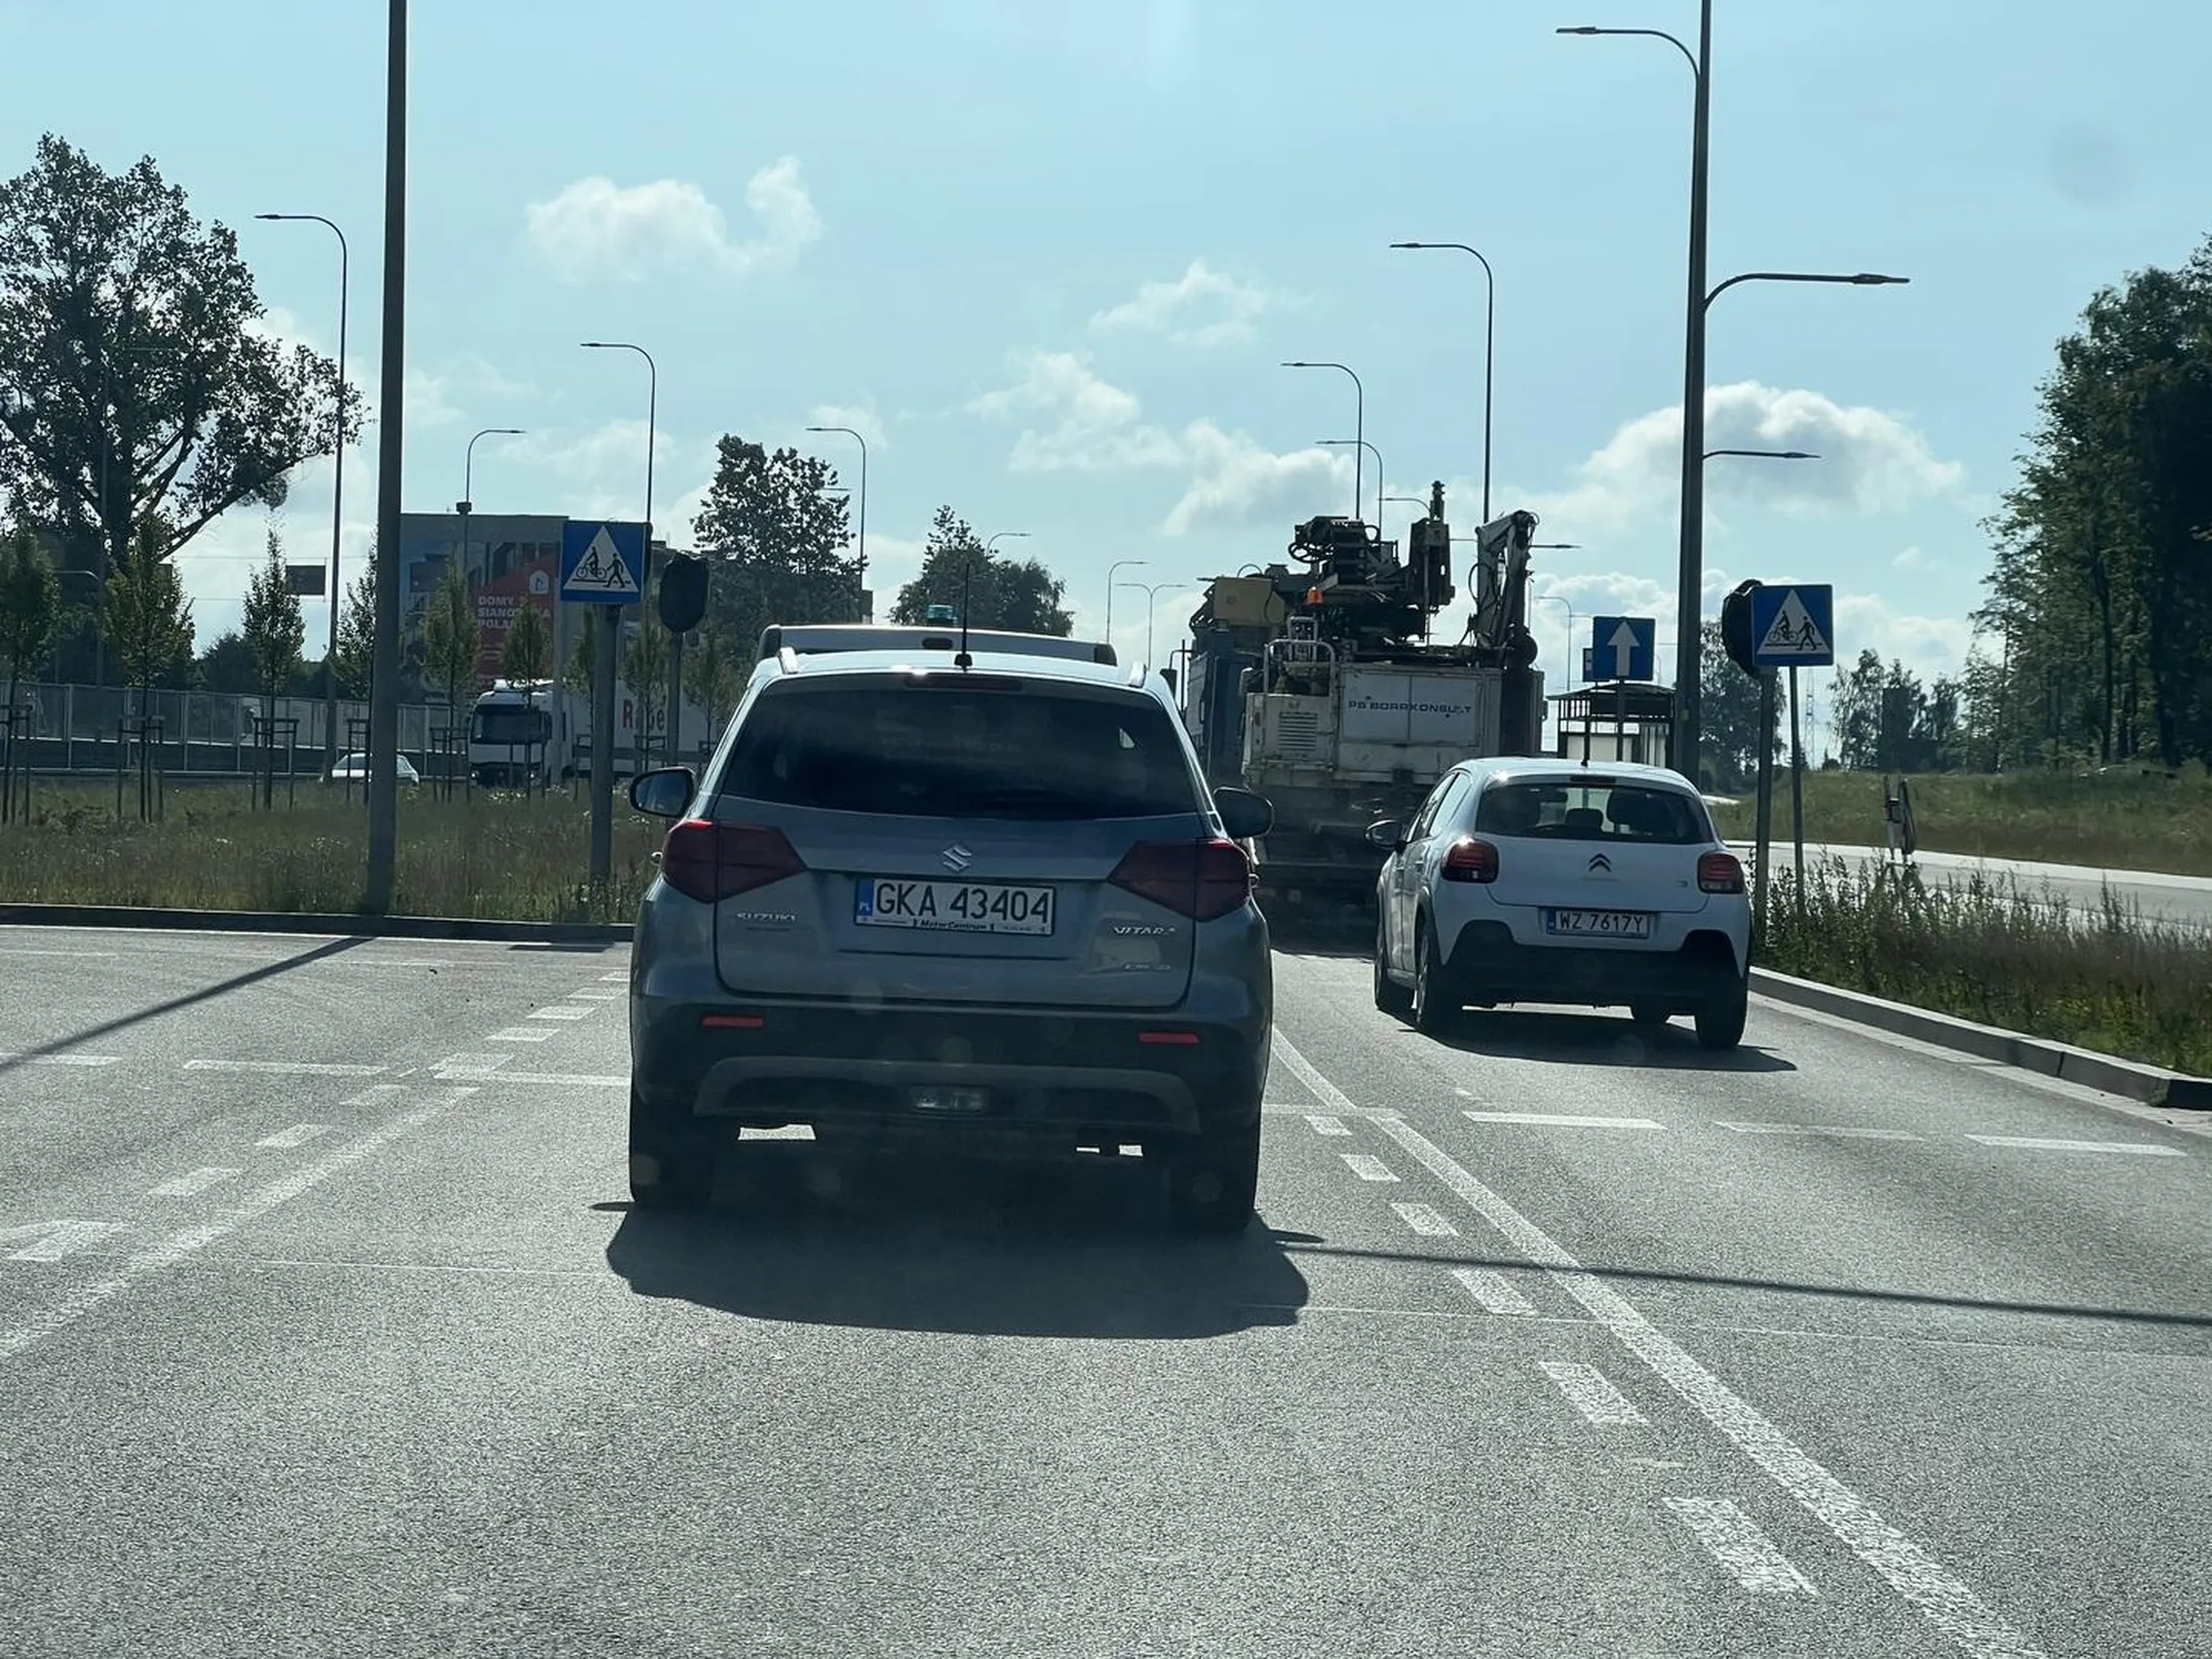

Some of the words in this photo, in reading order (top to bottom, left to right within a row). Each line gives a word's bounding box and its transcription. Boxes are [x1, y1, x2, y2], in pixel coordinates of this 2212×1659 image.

[478, 595, 514, 606] DOMY
[876, 882, 937, 918] GKA
[949, 886, 1050, 924] 43404
[1560, 912, 1583, 930] WZ
[1589, 913, 1643, 933] 7617Y
